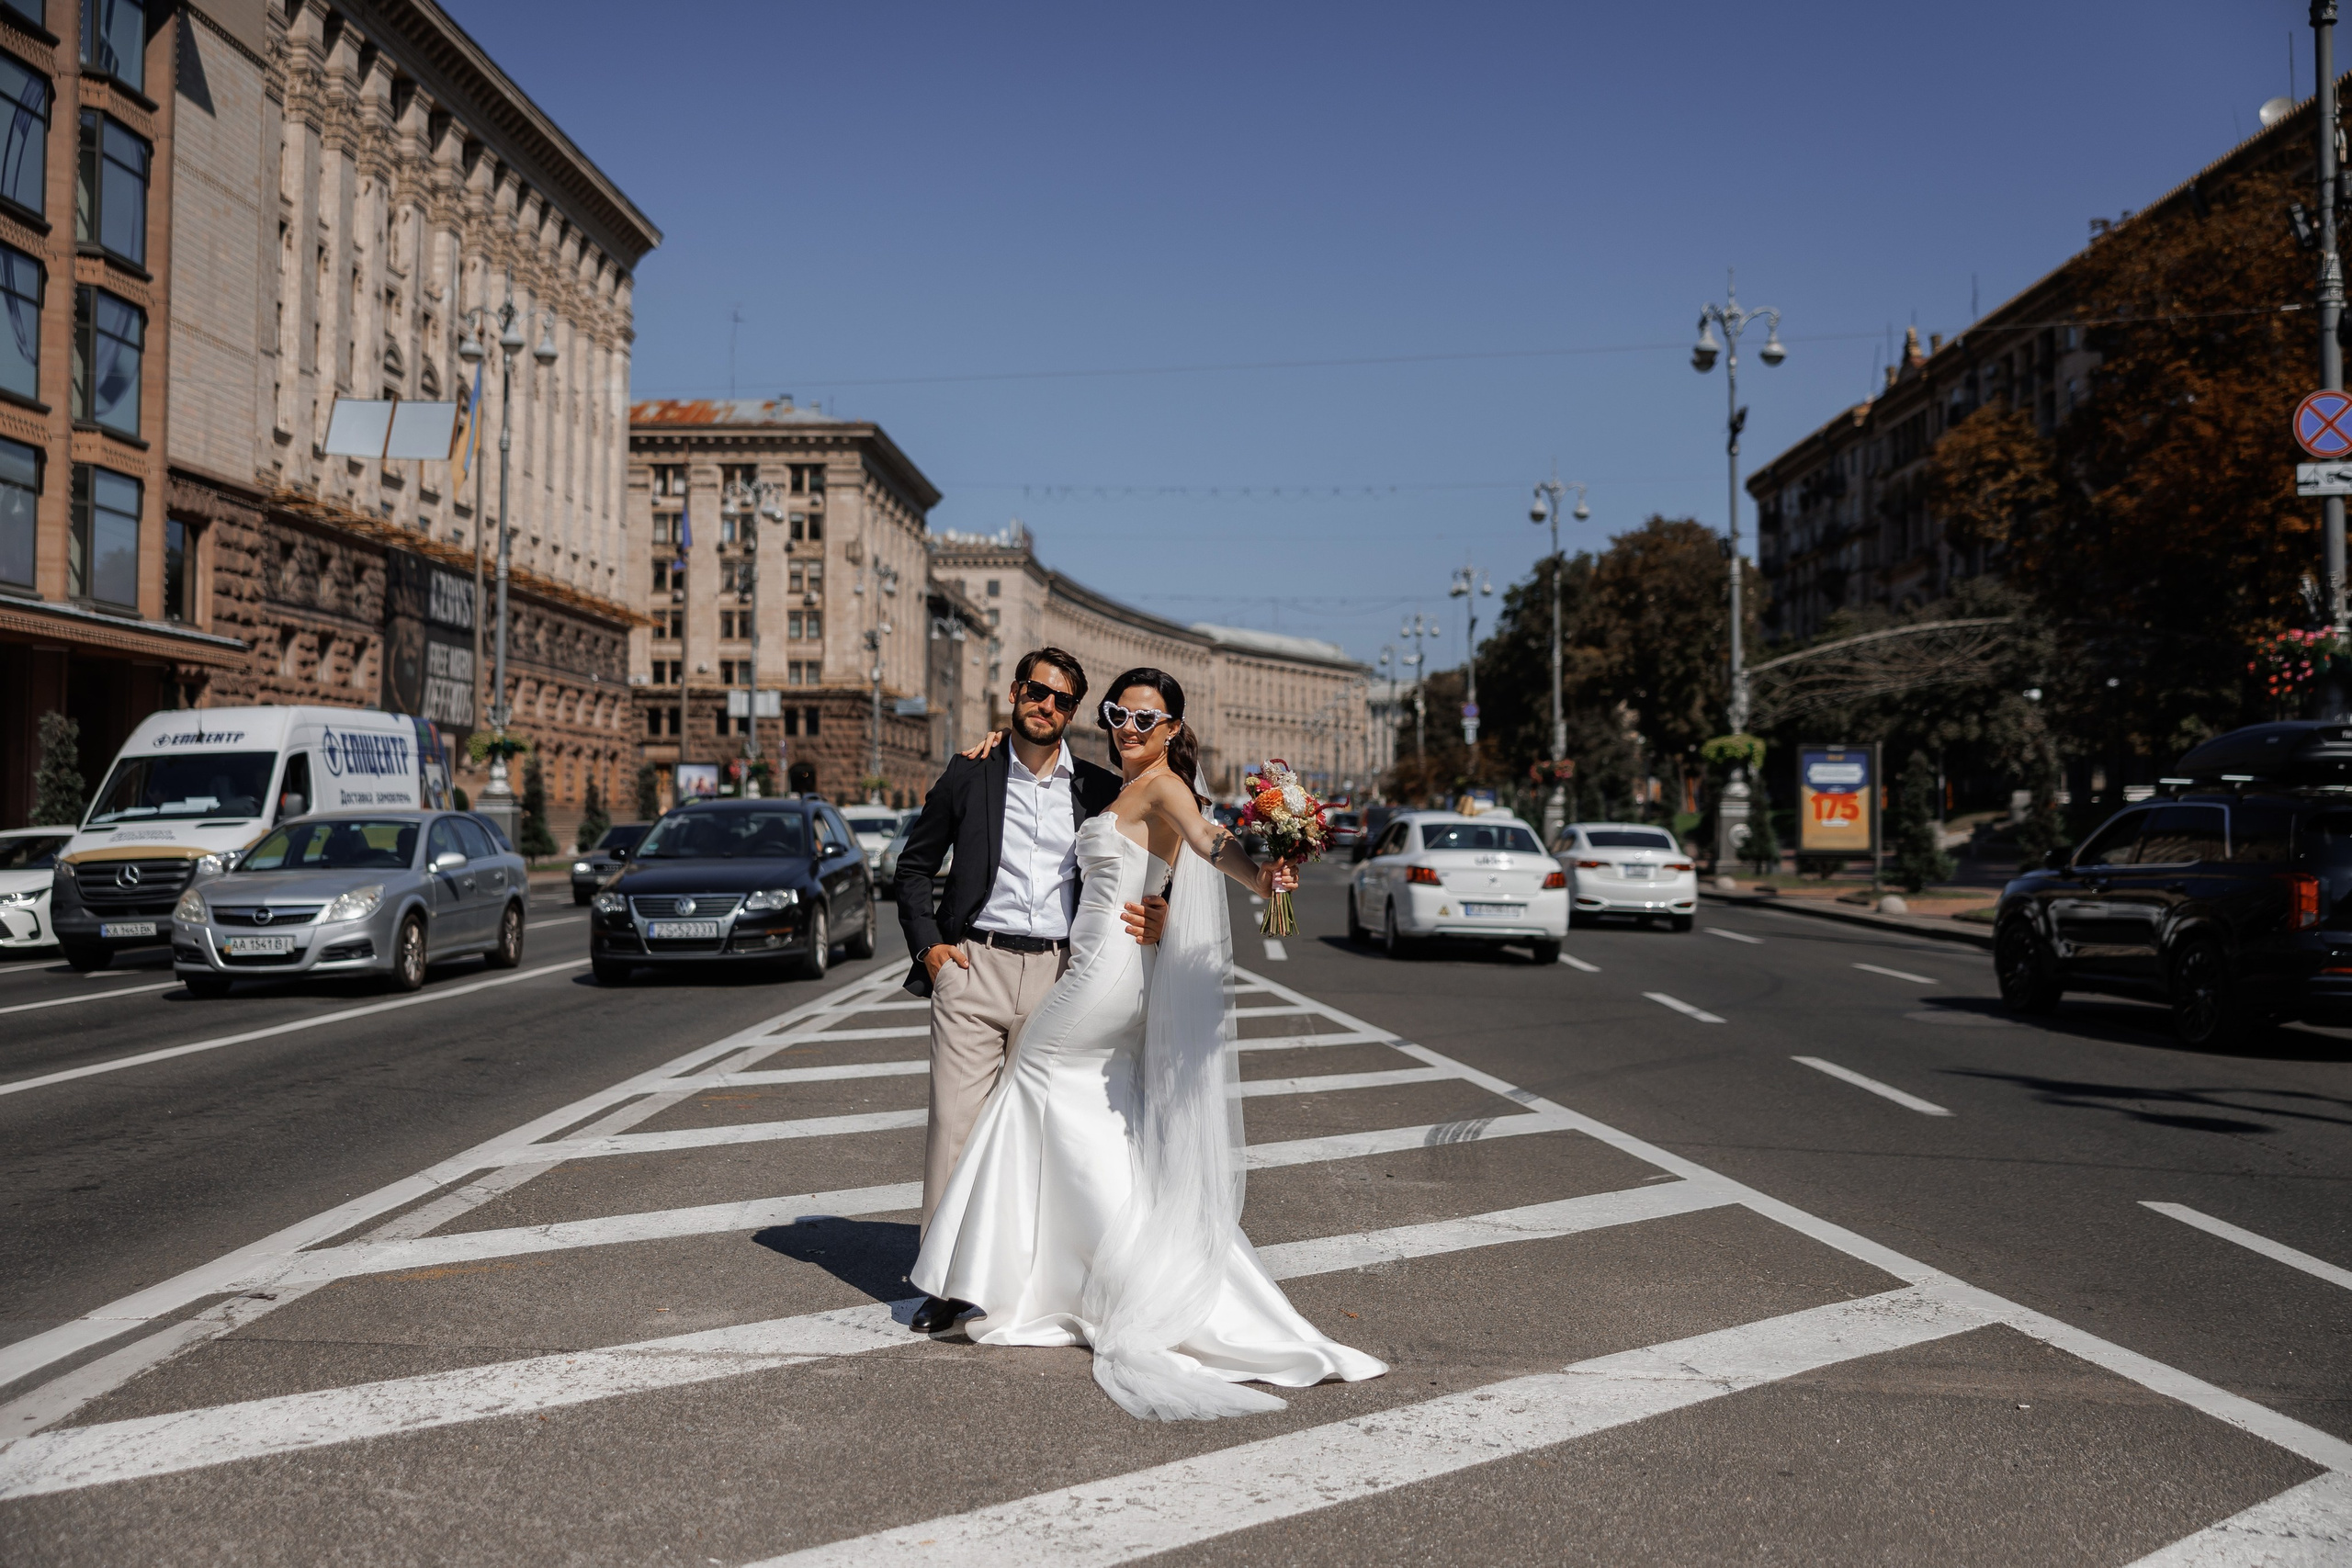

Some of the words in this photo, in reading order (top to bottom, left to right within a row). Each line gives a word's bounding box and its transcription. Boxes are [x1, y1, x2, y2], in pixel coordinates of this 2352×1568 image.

[340, 732, 409, 778] ЕПІЦЕНТР
[340, 789, 373, 806] Доставка
[1811, 792, 1860, 821] 175
[232, 939, 246, 951] AA
